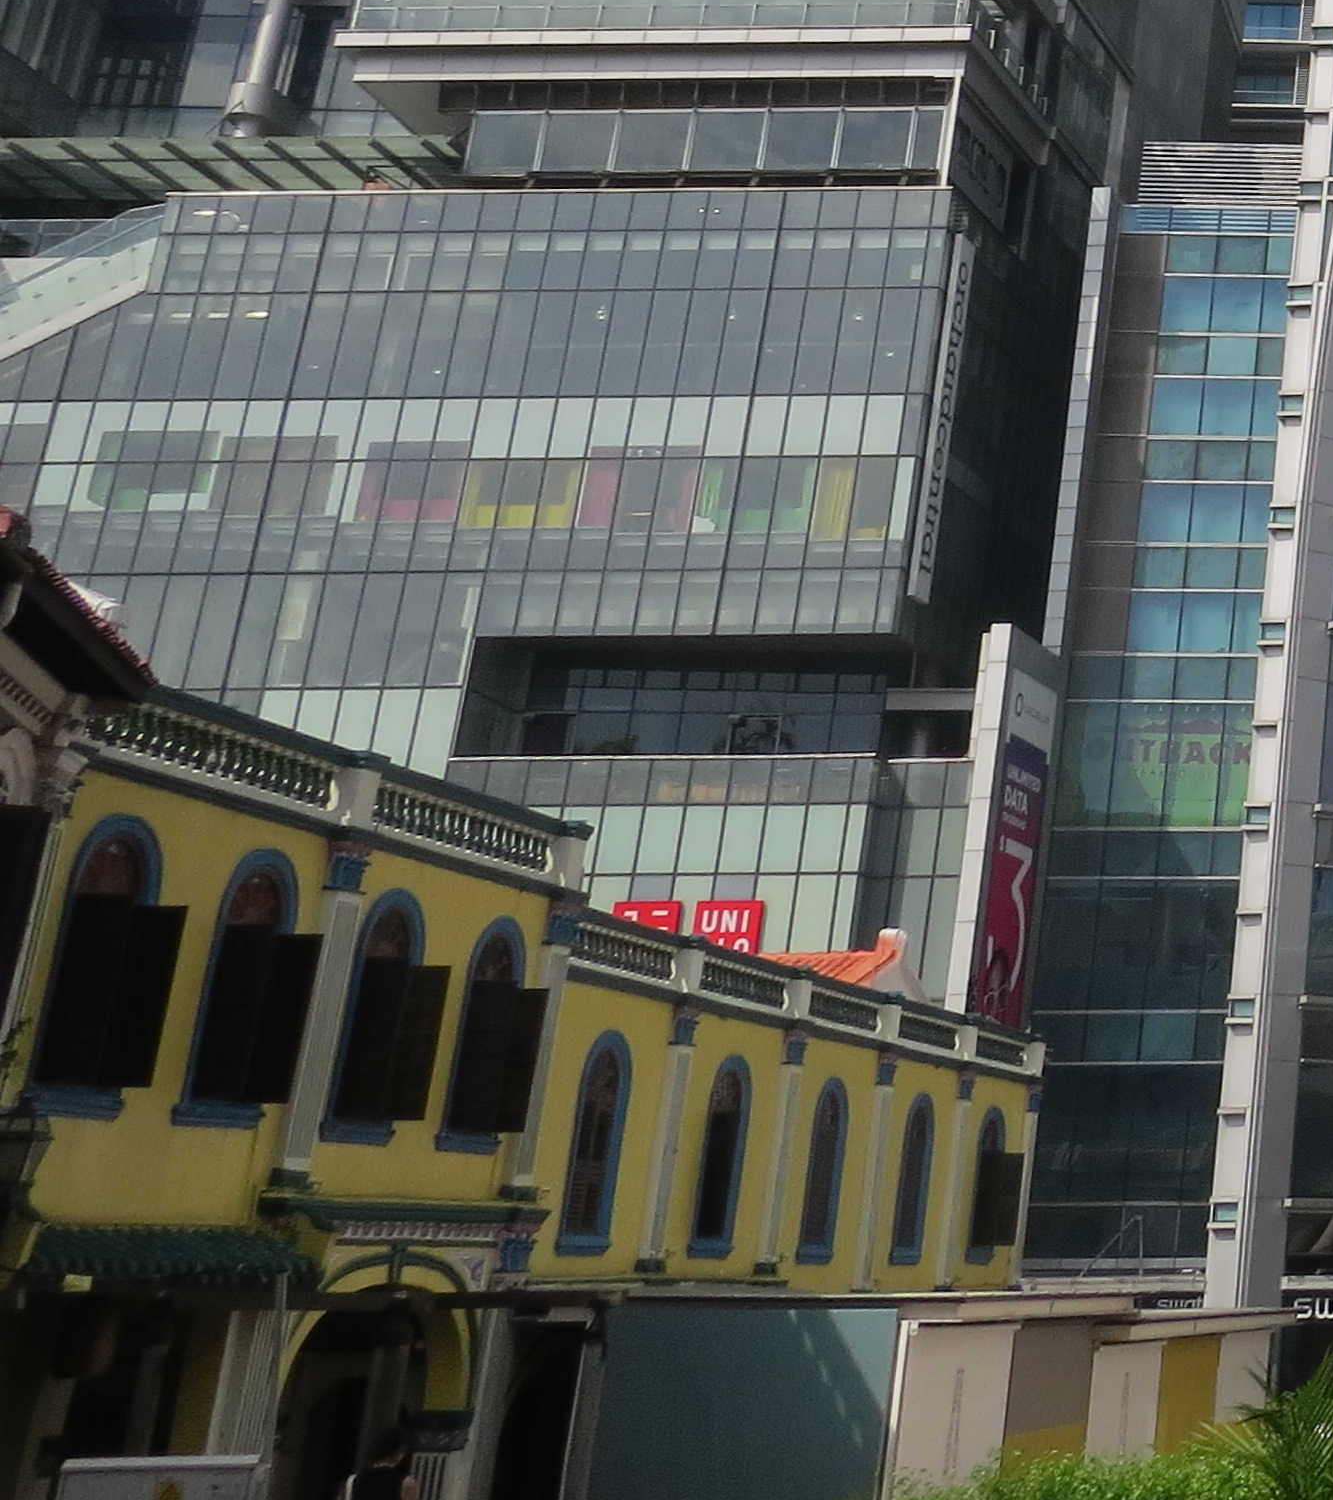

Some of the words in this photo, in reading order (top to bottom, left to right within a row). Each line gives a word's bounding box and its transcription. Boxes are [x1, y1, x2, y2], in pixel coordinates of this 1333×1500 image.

[919, 261, 969, 575] orchardcentral
[1004, 784, 1029, 816] DATA
[701, 909, 750, 933] UNI
